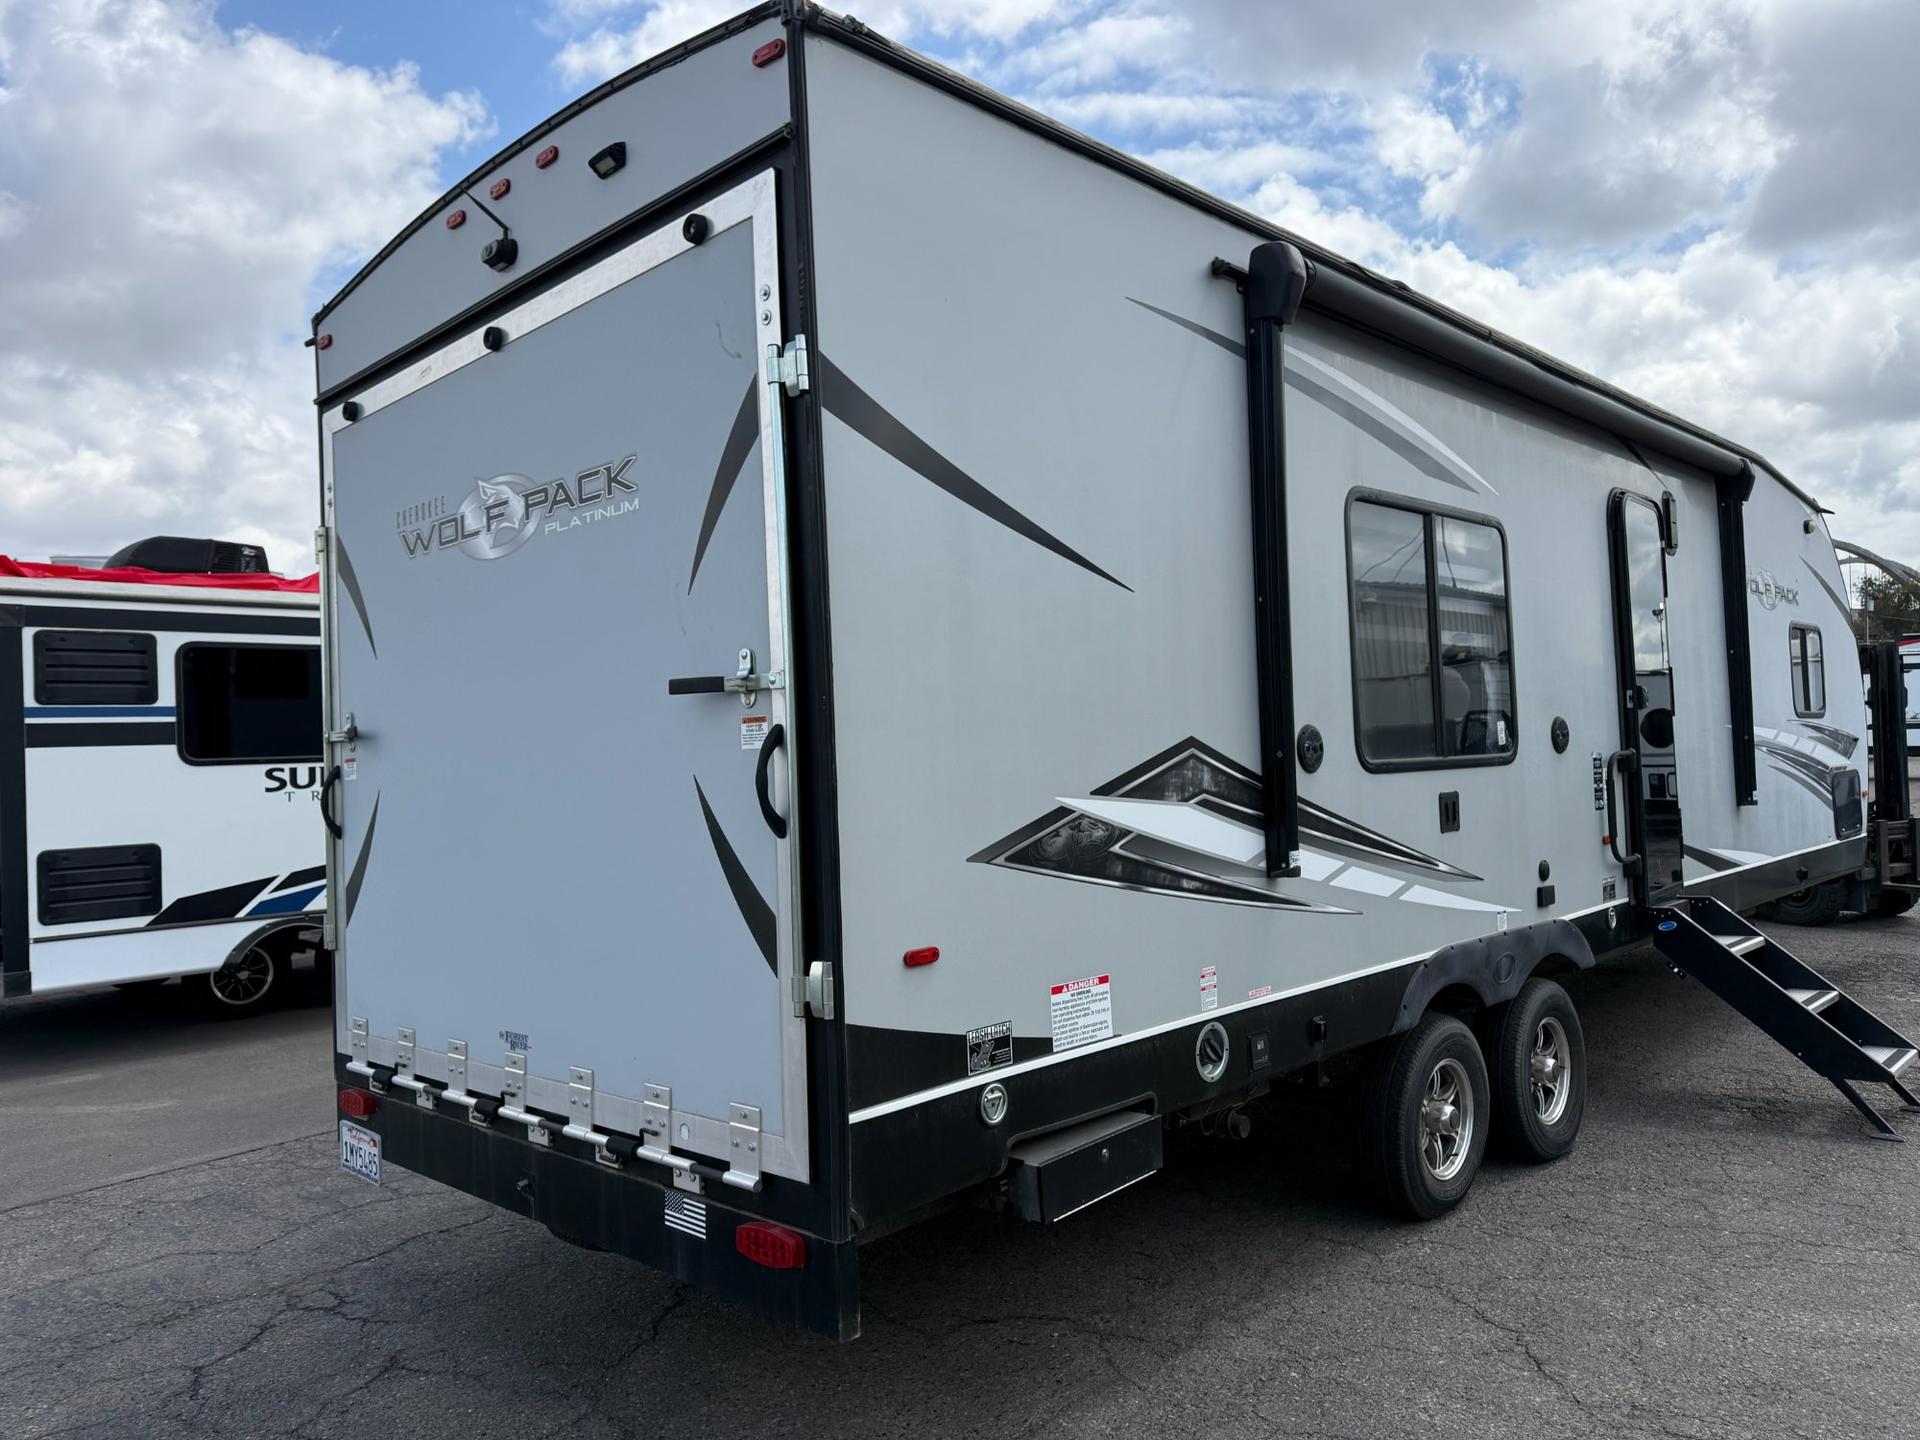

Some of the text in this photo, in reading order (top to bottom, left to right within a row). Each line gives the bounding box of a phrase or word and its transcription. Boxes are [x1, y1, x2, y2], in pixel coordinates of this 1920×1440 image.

[398, 454, 639, 559] WOLF PACK
[544, 498, 640, 535] PLATINUM
[1774, 585, 1800, 607] PACK
[1068, 977, 1100, 991] DANGER
[343, 1141, 378, 1176] 1MY5485
